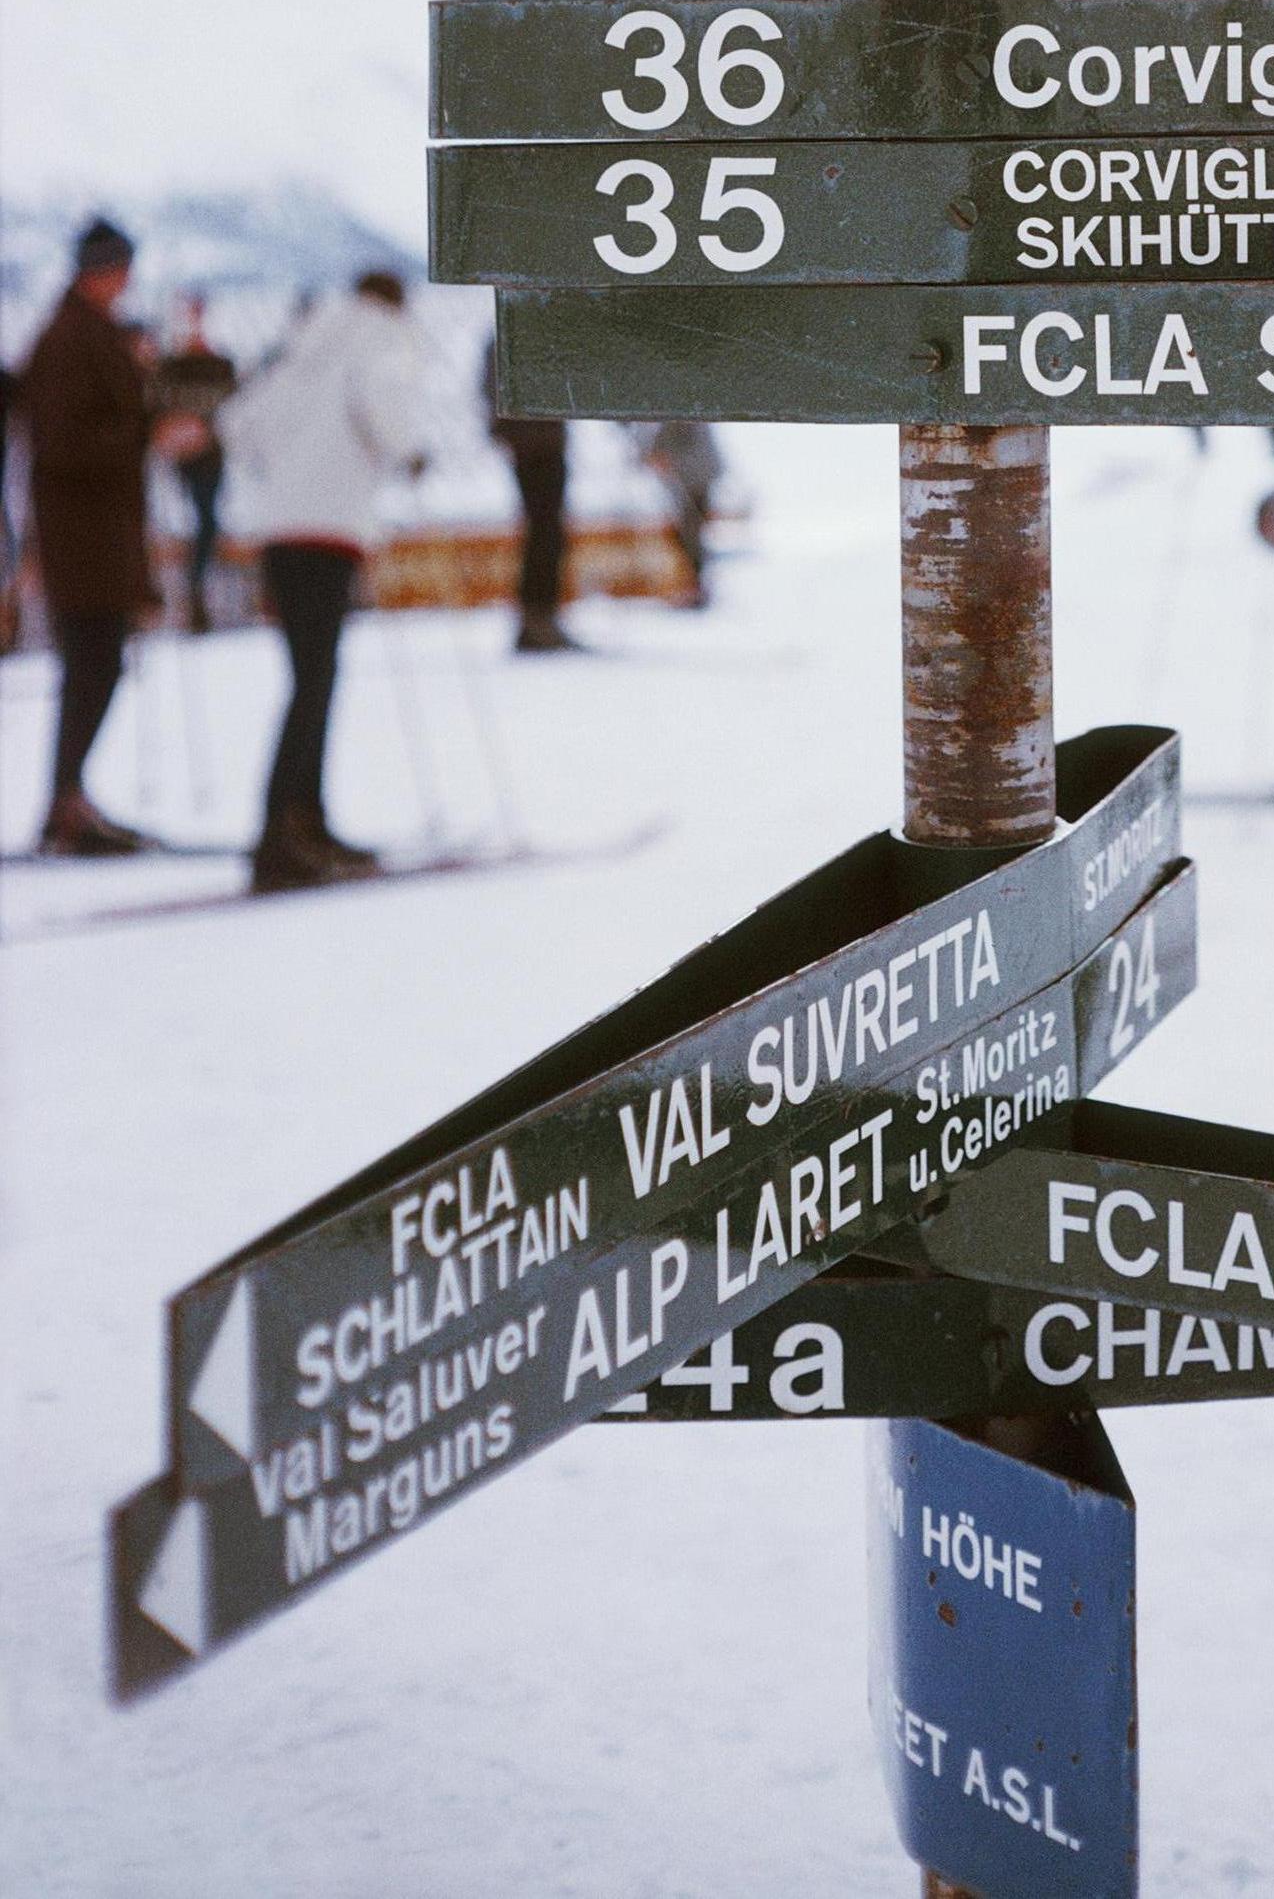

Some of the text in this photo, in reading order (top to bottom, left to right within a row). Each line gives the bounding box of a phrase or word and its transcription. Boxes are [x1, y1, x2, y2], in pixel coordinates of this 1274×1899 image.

[601, 7, 785, 131] 36
[592, 156, 785, 275] 35
[962, 311, 1209, 397] FCLA
[1107, 911, 1161, 1058] 24
[619, 908, 1001, 1200] VAL SUVRETTA
[391, 1146, 517, 1276] FCLA
[563, 1108, 894, 1403] ALP LARET
[296, 1177, 590, 1409] SCHLATTAIN
[346, 1303, 546, 1463] Saluver
[604, 1321, 846, 1415] 4a
[284, 1403, 513, 1586] Marguns
[921, 1505, 1043, 1613] HÖHE
[963, 1747, 1082, 1852] A.S.L.
